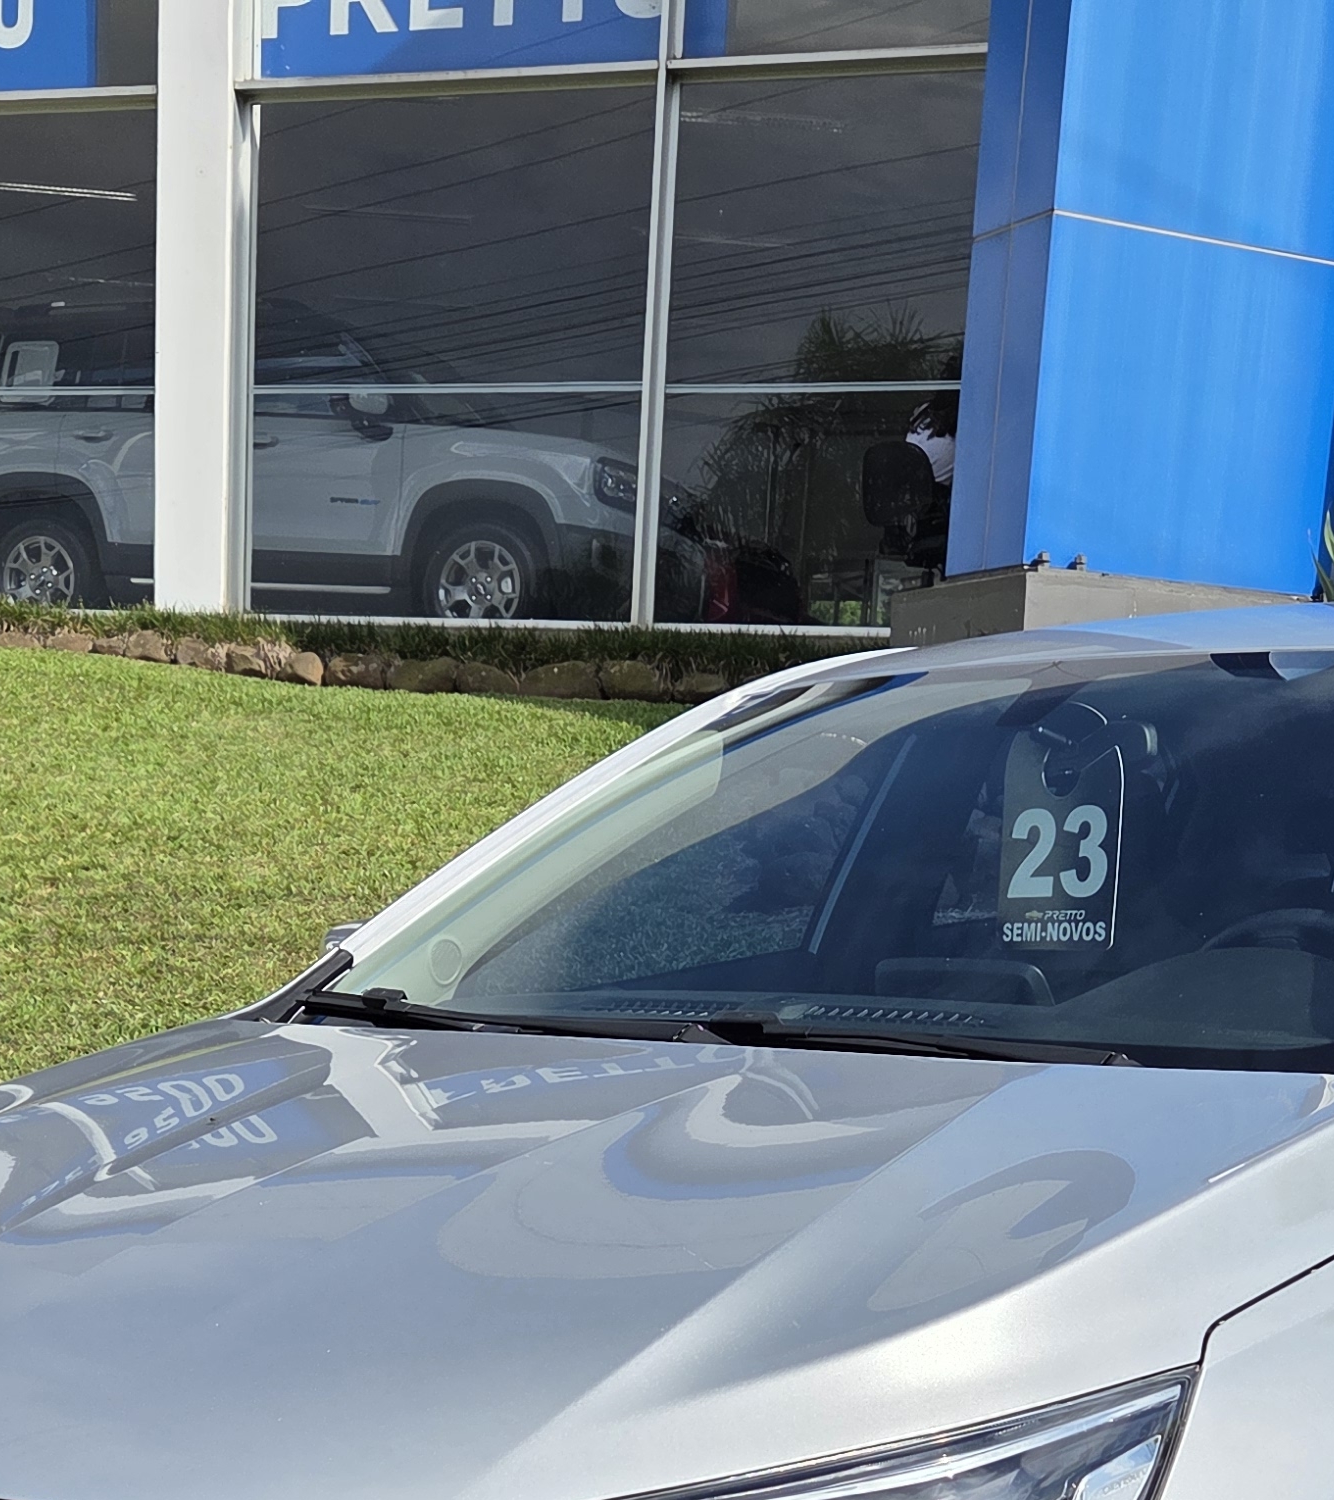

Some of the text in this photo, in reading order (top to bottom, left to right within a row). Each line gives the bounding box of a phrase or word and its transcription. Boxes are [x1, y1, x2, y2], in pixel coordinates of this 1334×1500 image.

[1007, 804, 1108, 898] 23
[1044, 909, 1086, 921] PRETTO
[1002, 920, 1107, 942] SEMI-NOVOS
